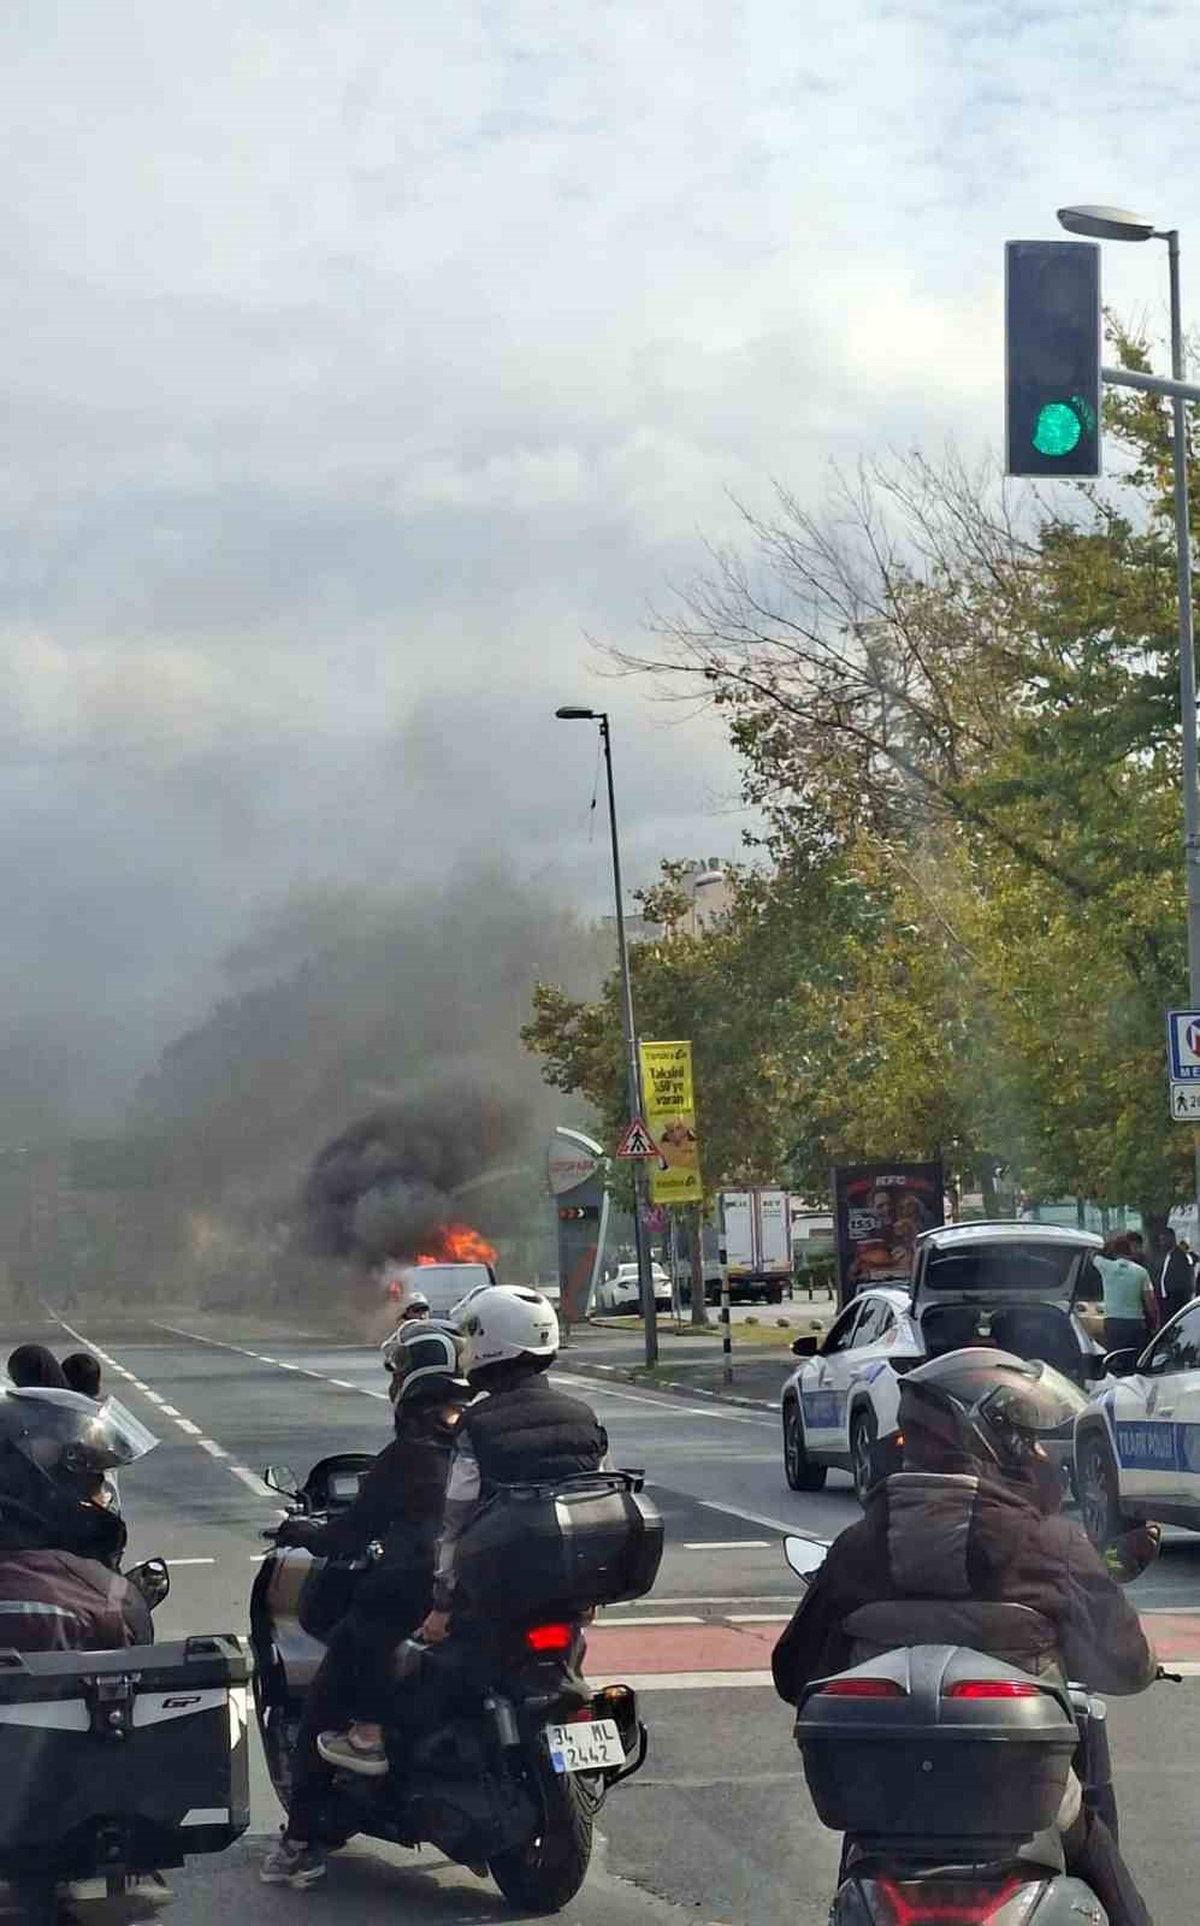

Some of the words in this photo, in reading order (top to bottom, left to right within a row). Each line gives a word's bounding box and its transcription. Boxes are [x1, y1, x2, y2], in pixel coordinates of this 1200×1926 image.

[876, 1175, 906, 1186] KFC
[554, 1727, 573, 1745] 34
[591, 1723, 614, 1741] ML
[567, 1745, 611, 1767] 2442
